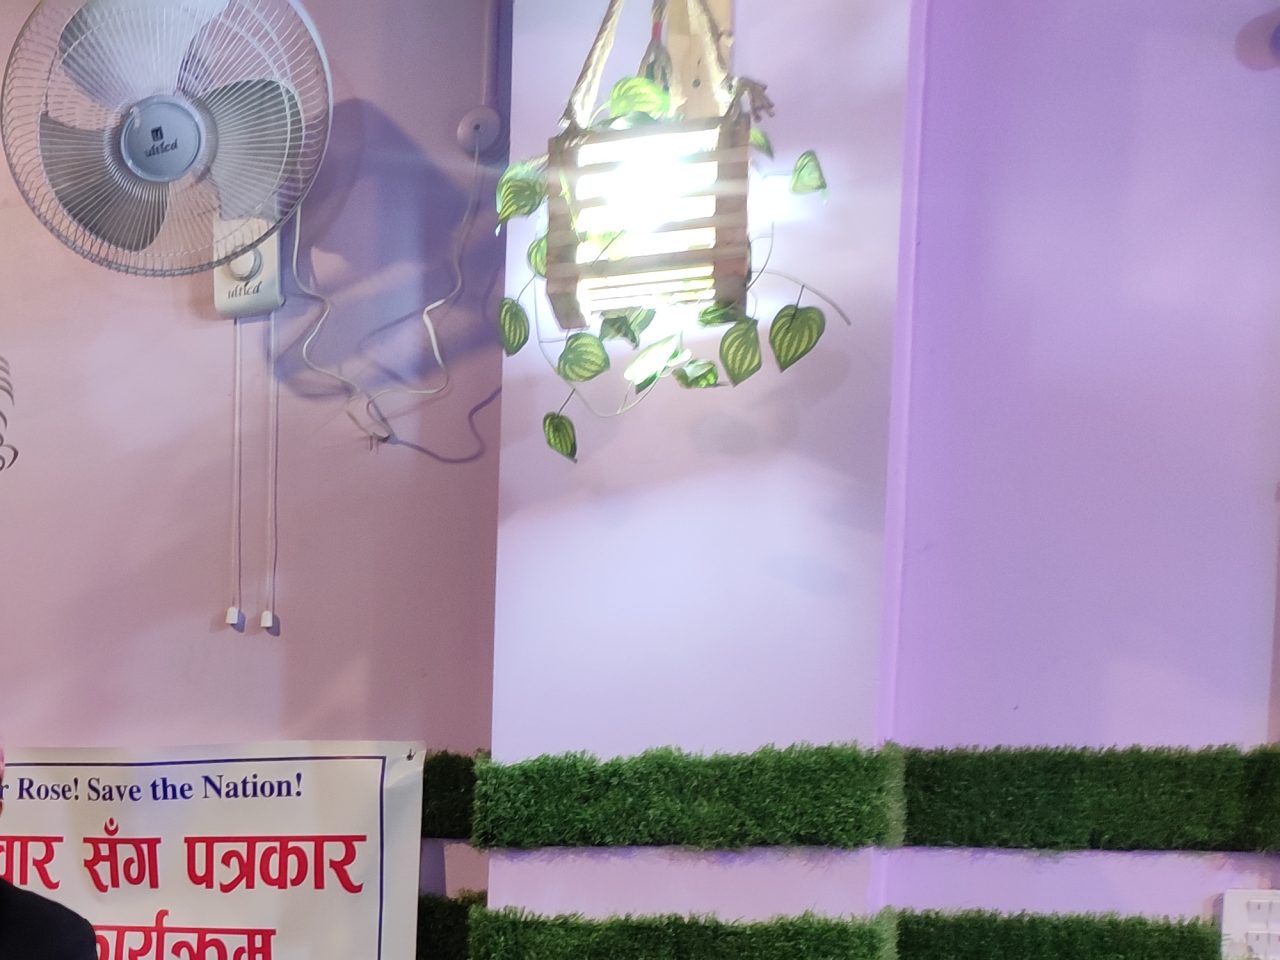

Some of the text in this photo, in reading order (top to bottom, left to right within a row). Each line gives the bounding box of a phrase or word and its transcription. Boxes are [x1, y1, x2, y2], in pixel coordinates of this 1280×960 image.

[18, 777, 80, 801] Rose!
[87, 778, 142, 802] Save
[150, 777, 194, 800] the
[201, 772, 303, 799] Nation!
[82, 817, 162, 893] सँग
[183, 834, 368, 894] पत्रकार
